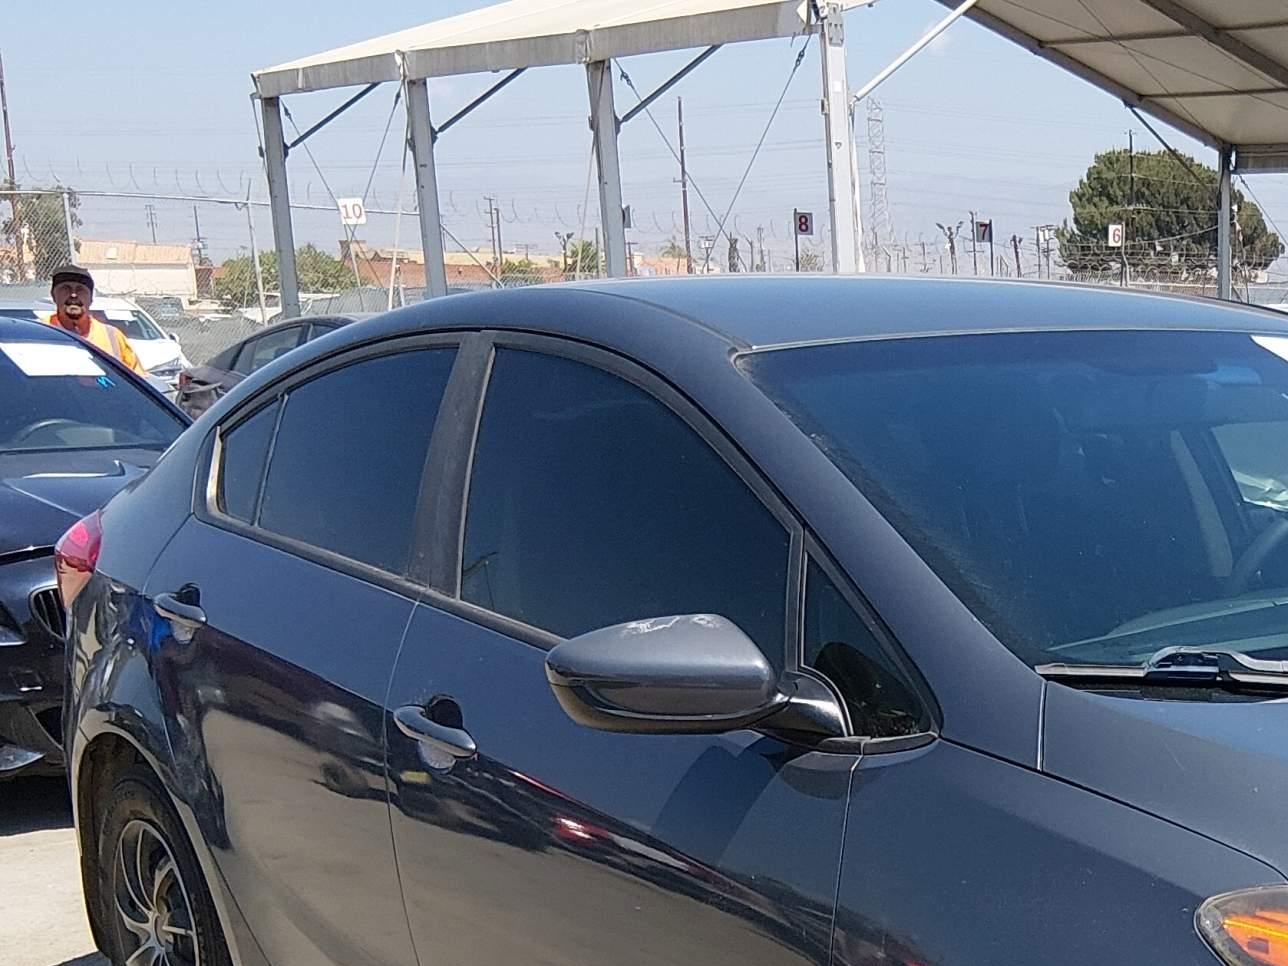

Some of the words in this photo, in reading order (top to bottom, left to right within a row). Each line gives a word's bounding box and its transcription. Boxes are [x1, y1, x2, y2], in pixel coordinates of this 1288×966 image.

[341, 203, 362, 219] 10
[798, 214, 809, 232] 8
[979, 223, 989, 241] 7
[1112, 227, 1121, 244] 6
